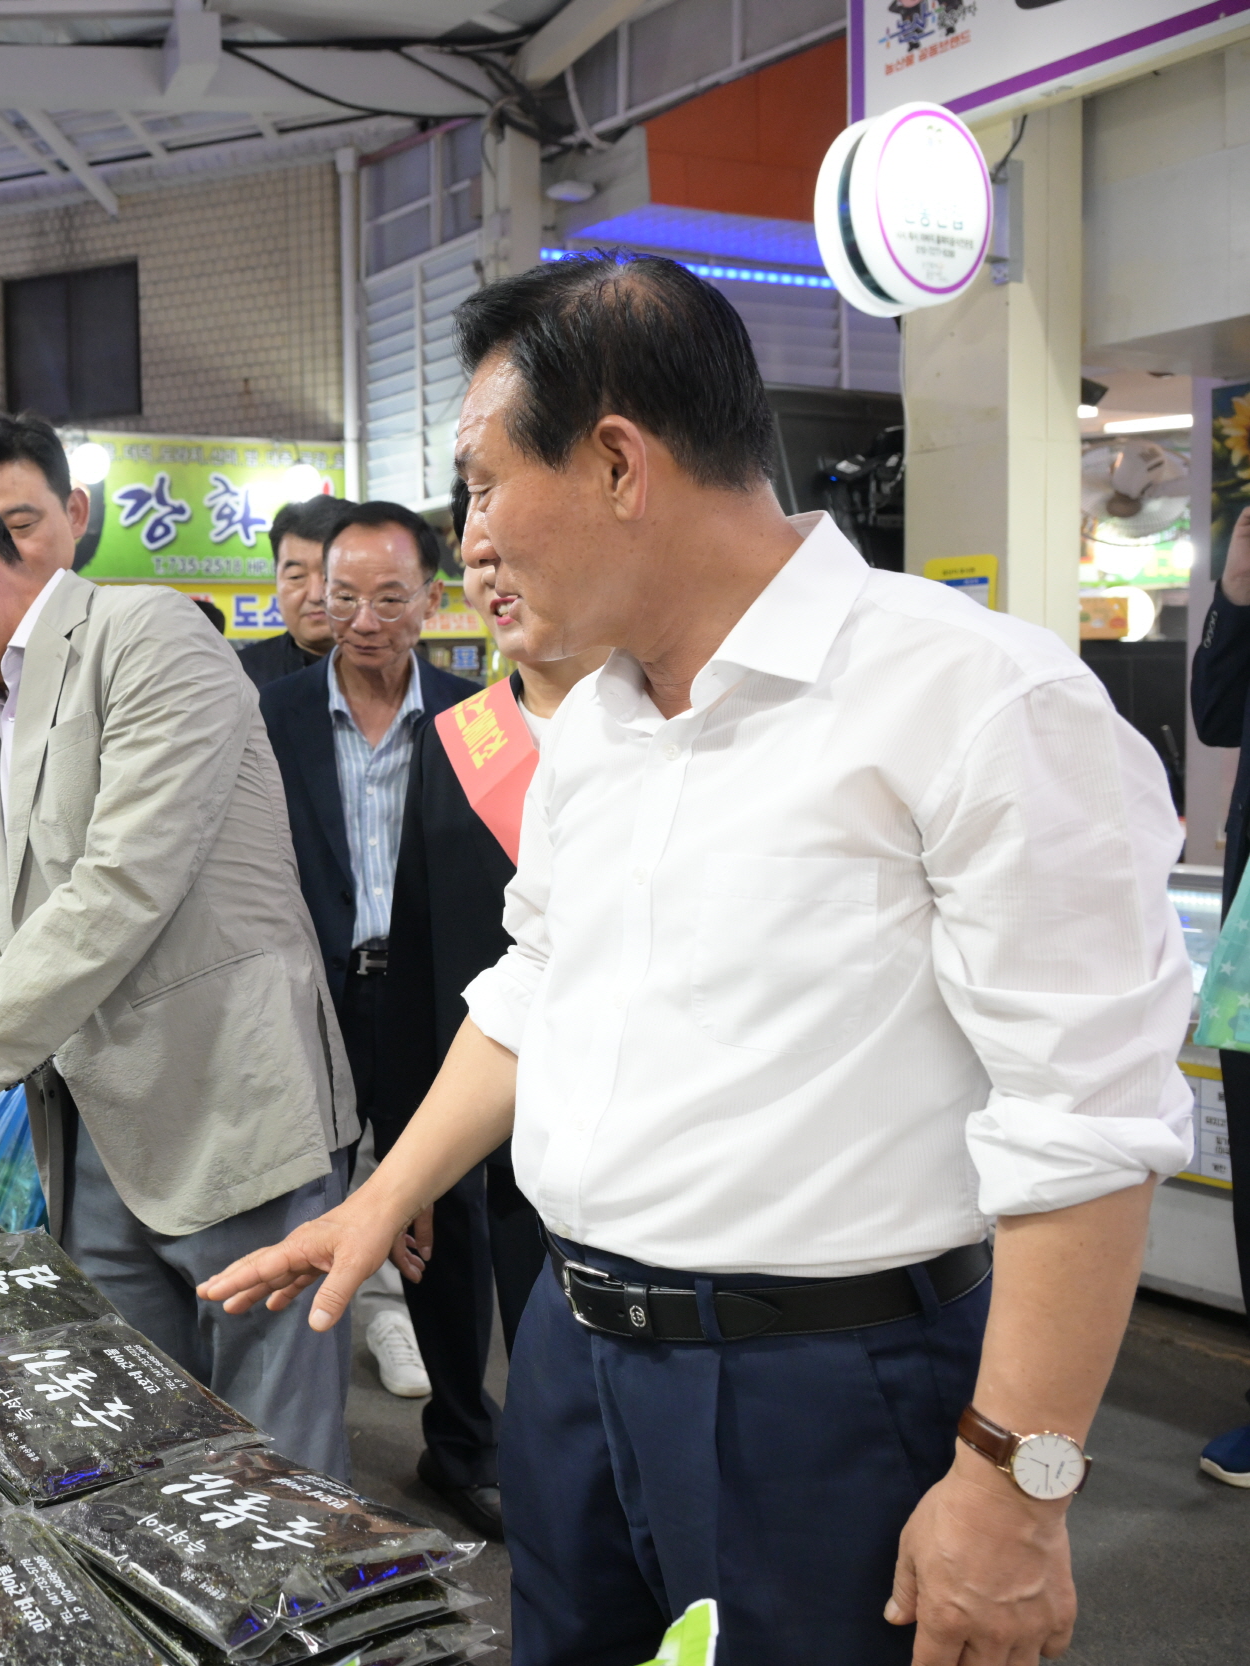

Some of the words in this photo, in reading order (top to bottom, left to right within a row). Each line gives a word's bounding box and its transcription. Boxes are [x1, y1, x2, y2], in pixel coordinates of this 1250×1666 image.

[103, 1348, 135, 1371] 건어물
[128, 1370, 161, 1394] 민호네
[137, 1513, 207, 1556] 즉석구이
[21, 1558, 63, 1606] 041-733-5779
[34, 1554, 78, 1603] 010-8456-2005
[13, 1597, 53, 1633] 민호네
